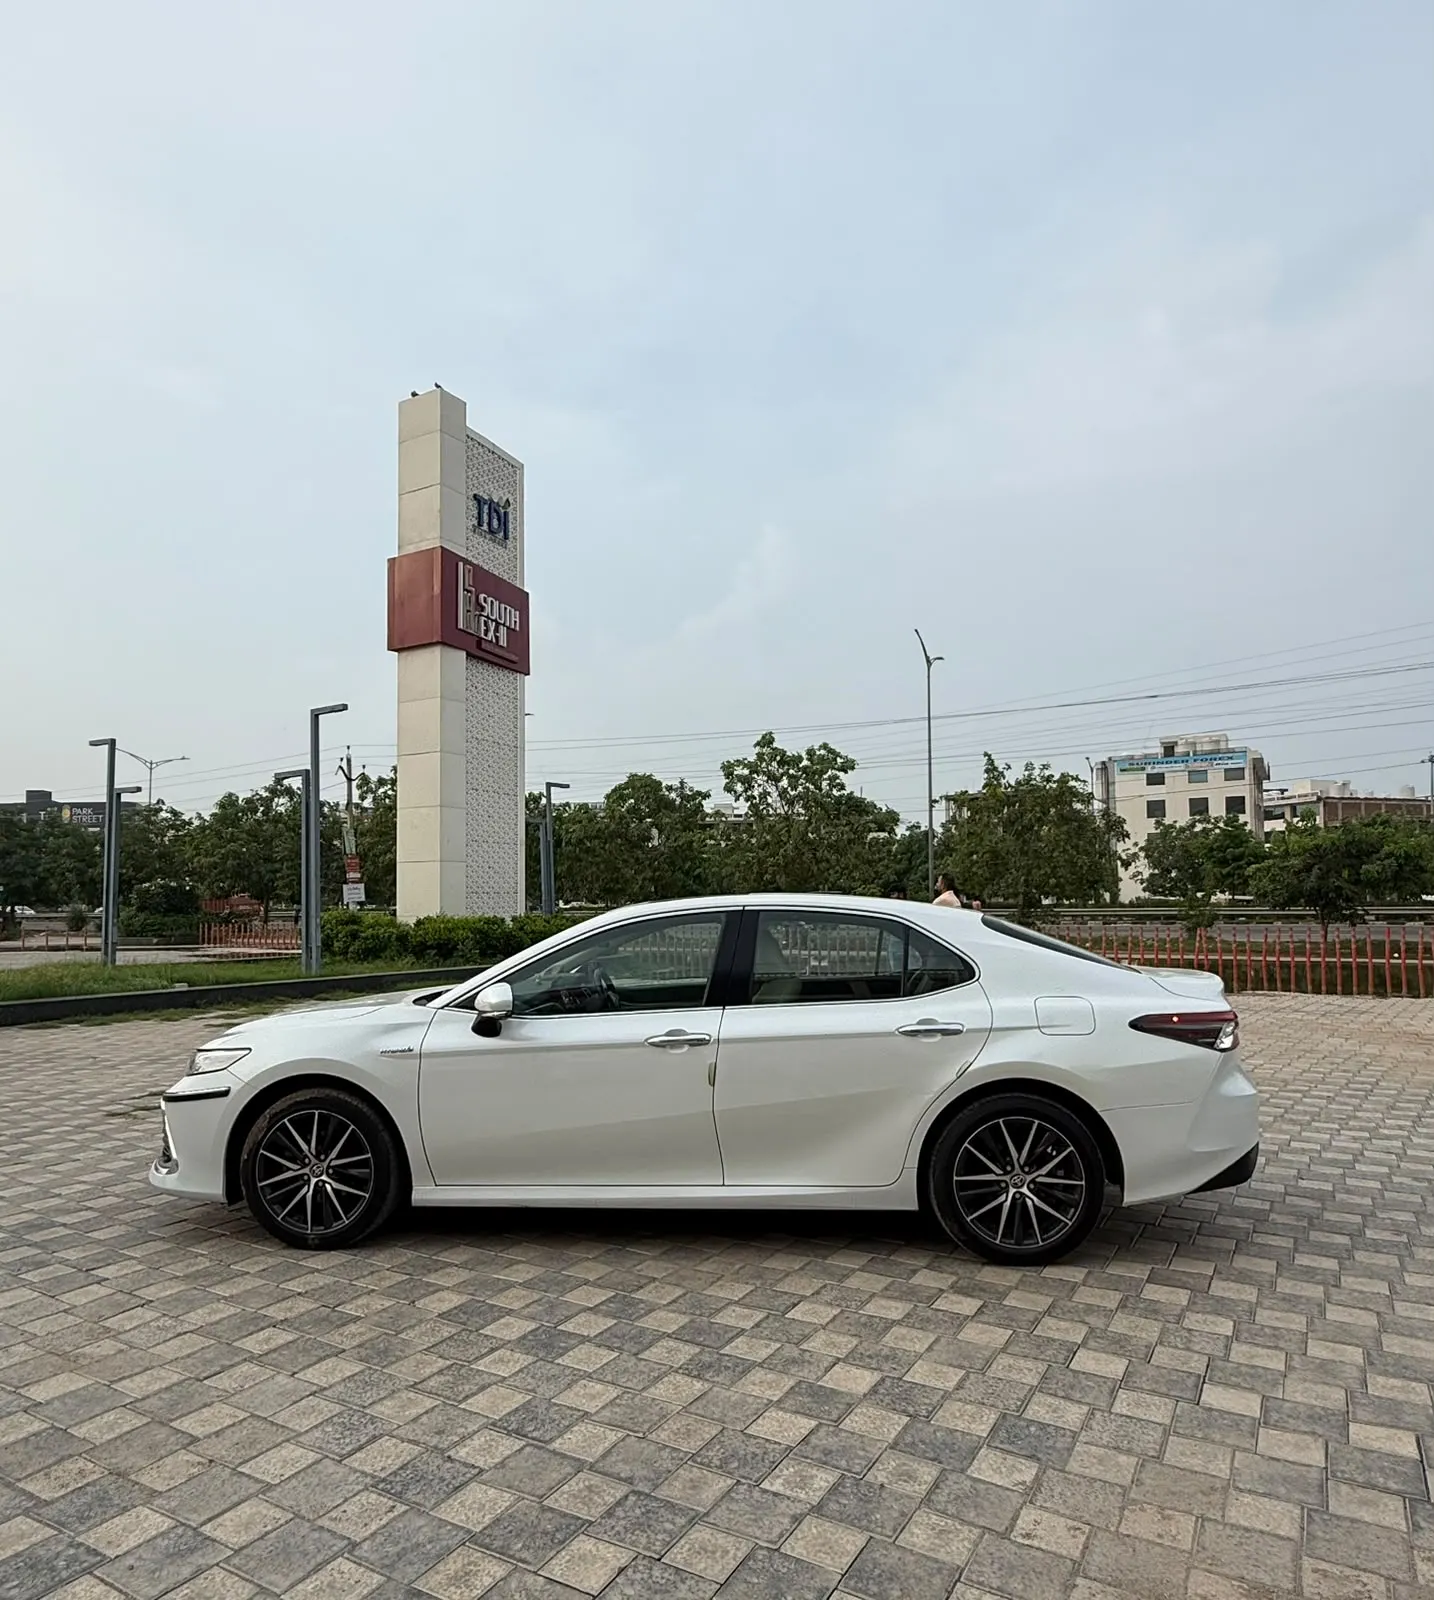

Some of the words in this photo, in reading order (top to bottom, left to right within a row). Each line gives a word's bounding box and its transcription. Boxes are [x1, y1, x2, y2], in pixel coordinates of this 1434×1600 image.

[473, 493, 510, 540] TDI
[479, 593, 520, 631] SOUTH
[72, 807, 93, 815] PARK
[72, 815, 103, 823] STREET
